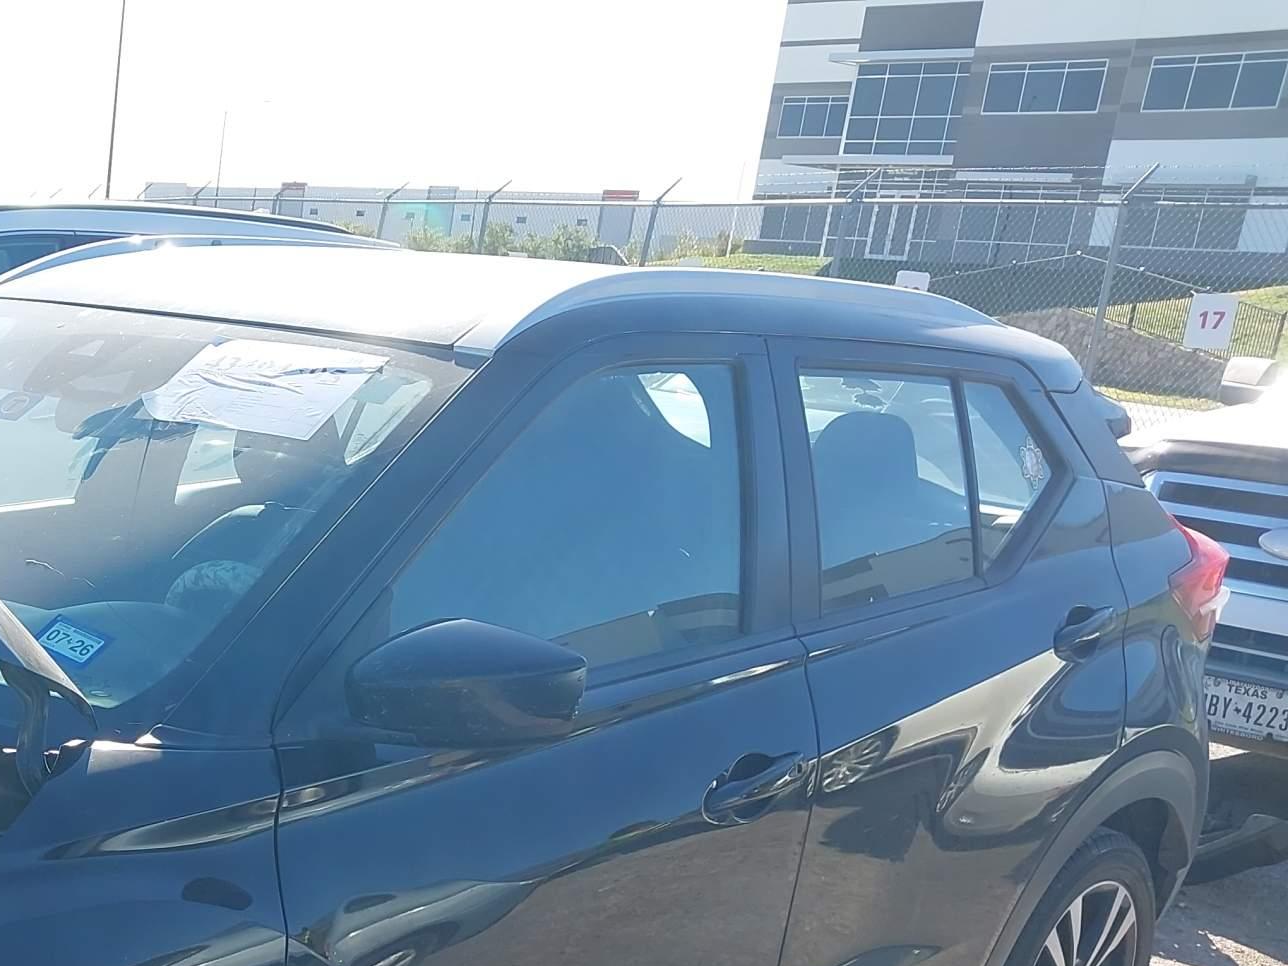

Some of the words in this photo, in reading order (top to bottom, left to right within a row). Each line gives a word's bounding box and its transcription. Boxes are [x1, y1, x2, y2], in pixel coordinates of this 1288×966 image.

[1199, 310, 1226, 329] 17
[1227, 684, 1268, 699] TEXAS
[1205, 693, 1232, 719] BY
